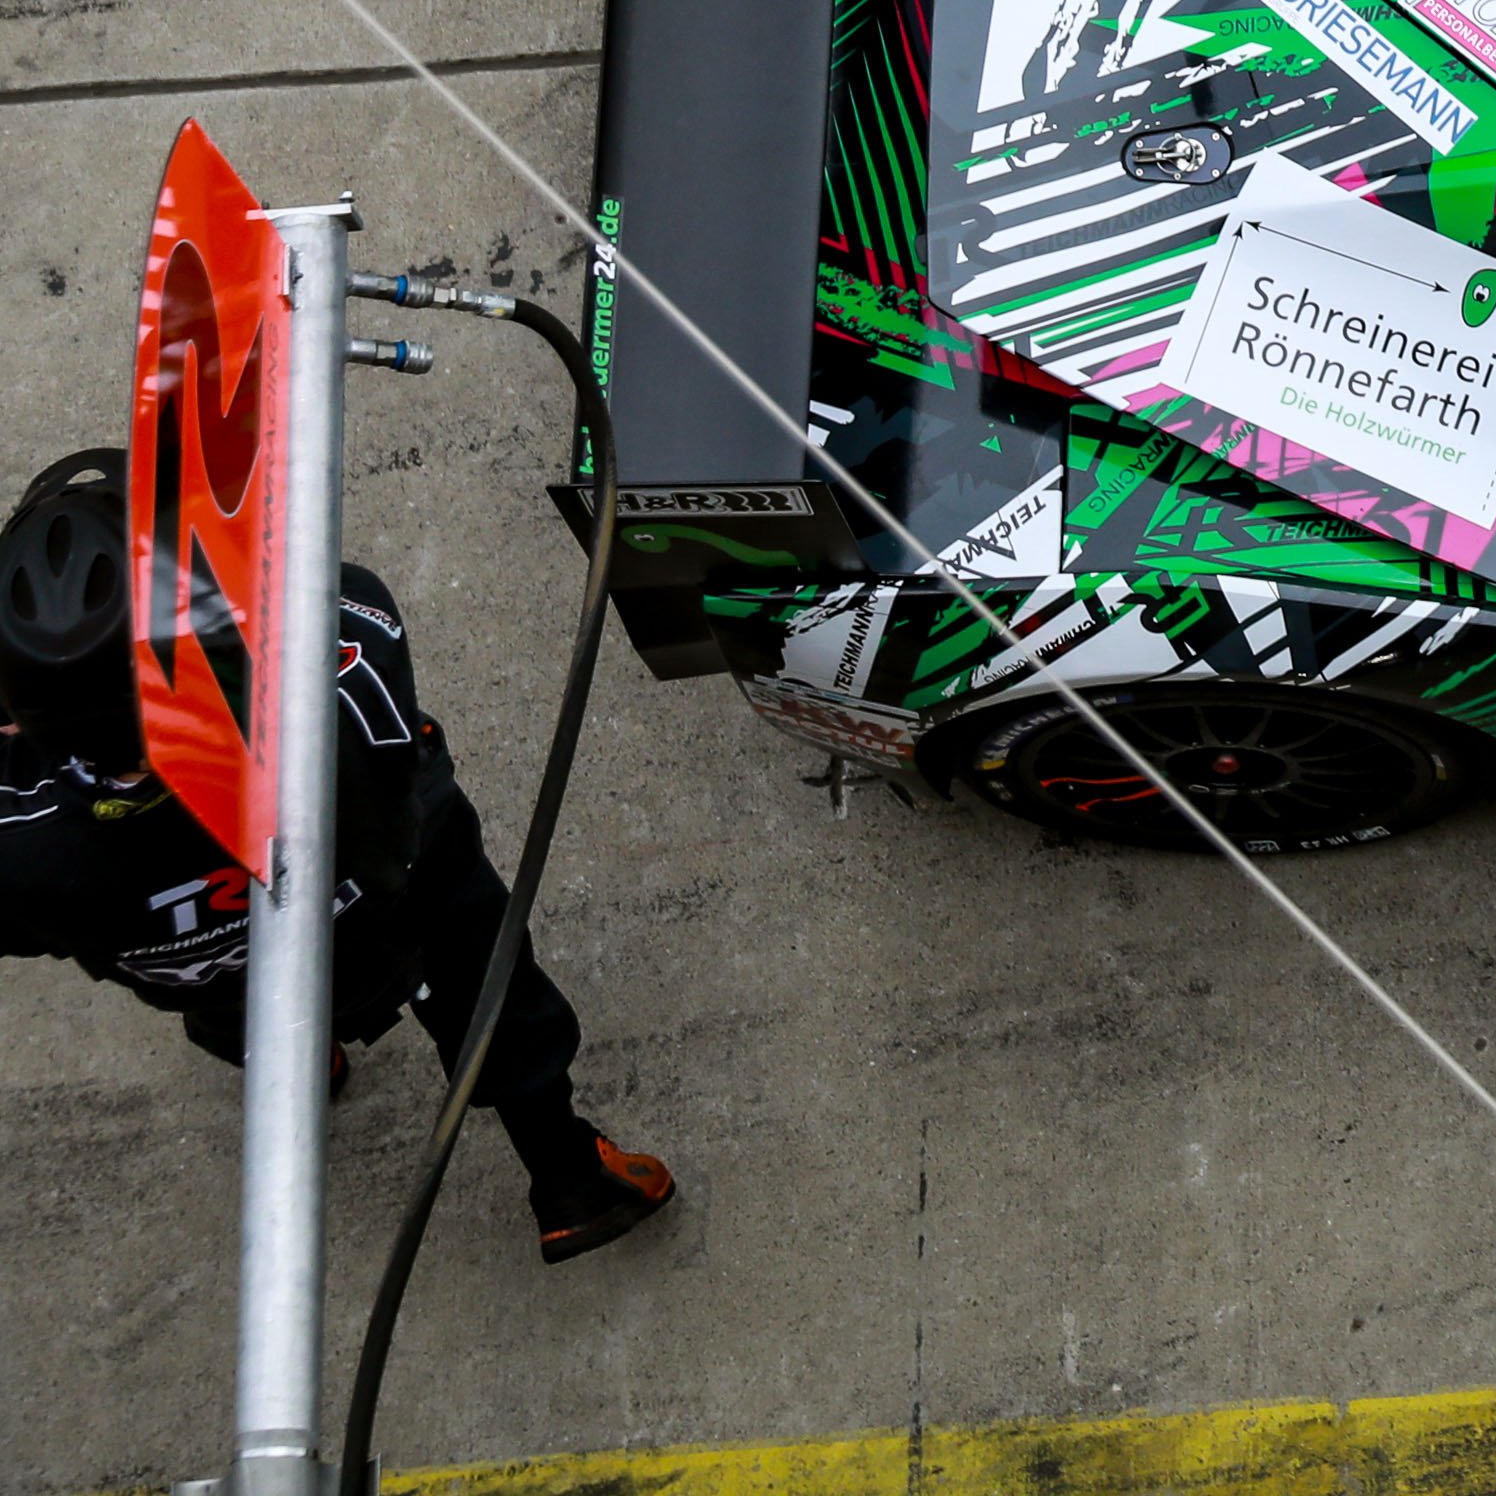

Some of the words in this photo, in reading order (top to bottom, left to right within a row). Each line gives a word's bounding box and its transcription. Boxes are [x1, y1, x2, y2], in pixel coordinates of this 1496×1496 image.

[1231, 321, 1483, 437] Rönnefarth
[1280, 385, 1320, 416] Die
[1324, 400, 1467, 466] Holzwürmer
